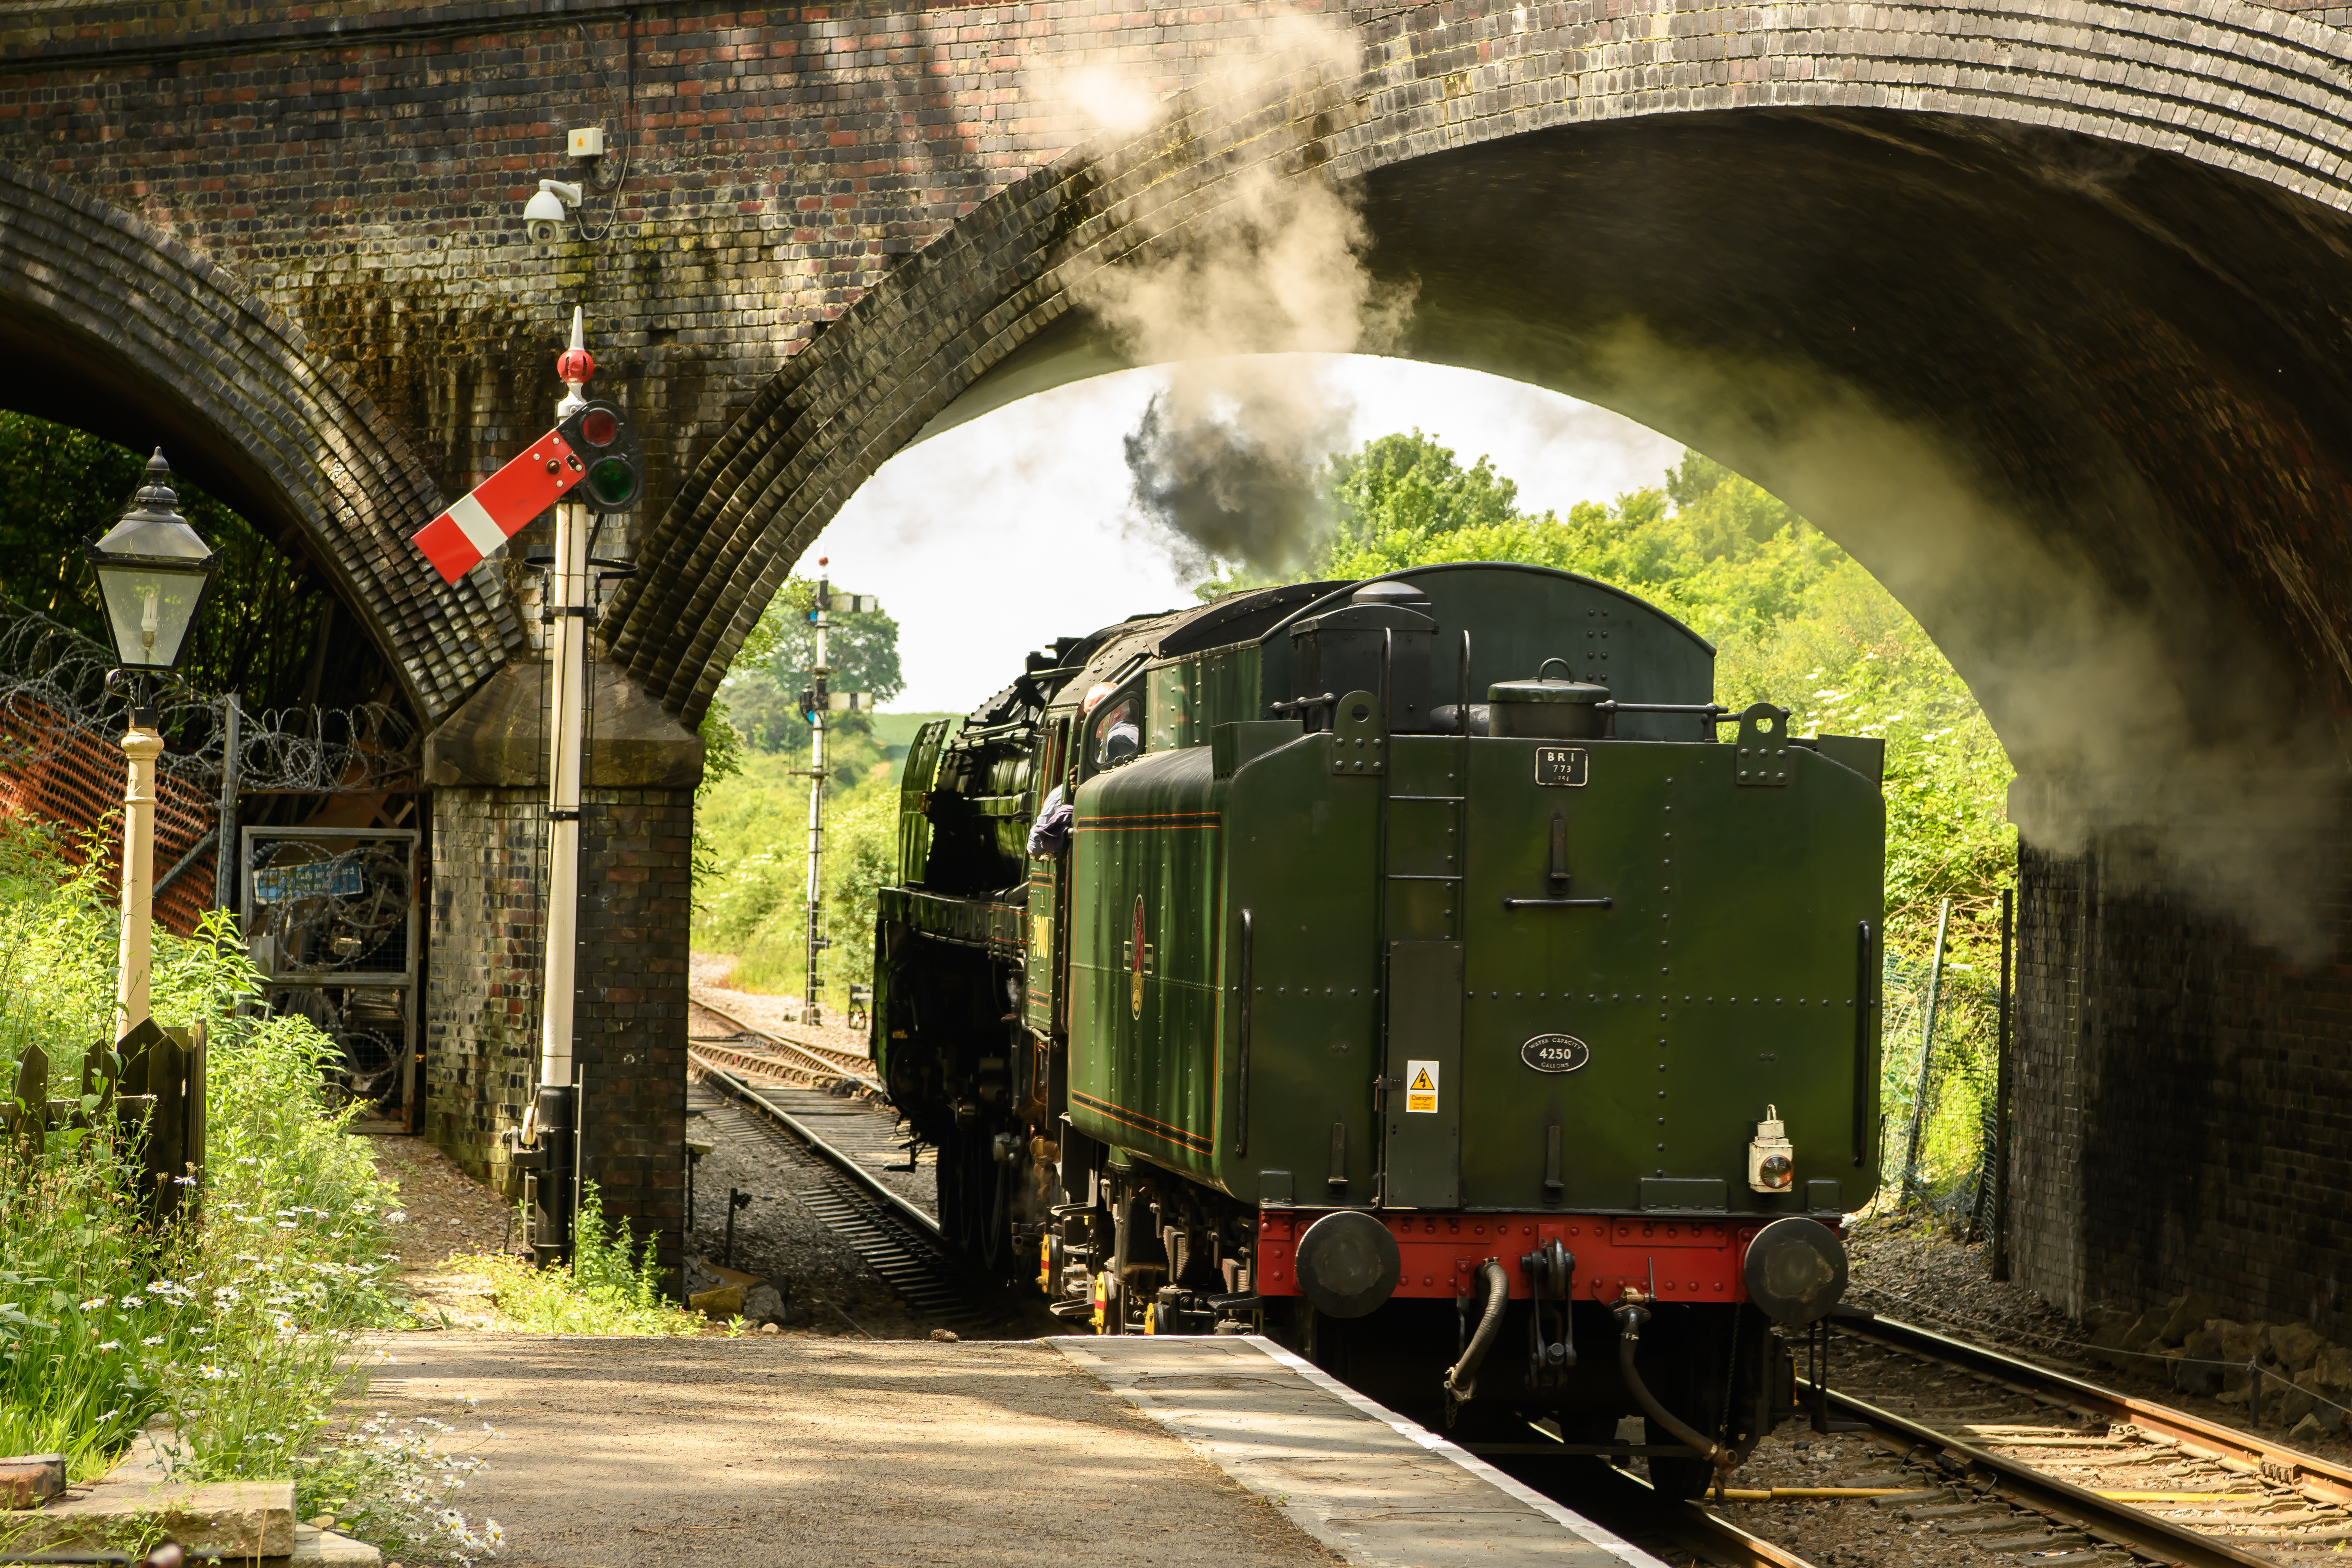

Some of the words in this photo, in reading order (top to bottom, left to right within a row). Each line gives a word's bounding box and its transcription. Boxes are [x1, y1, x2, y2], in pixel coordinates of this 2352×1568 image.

[1553, 765, 1571, 773] 773
[1528, 1039, 1549, 1049] WATER
[1552, 1038, 1582, 1050] CAPACITY
[1539, 1048, 1571, 1059] 4250
